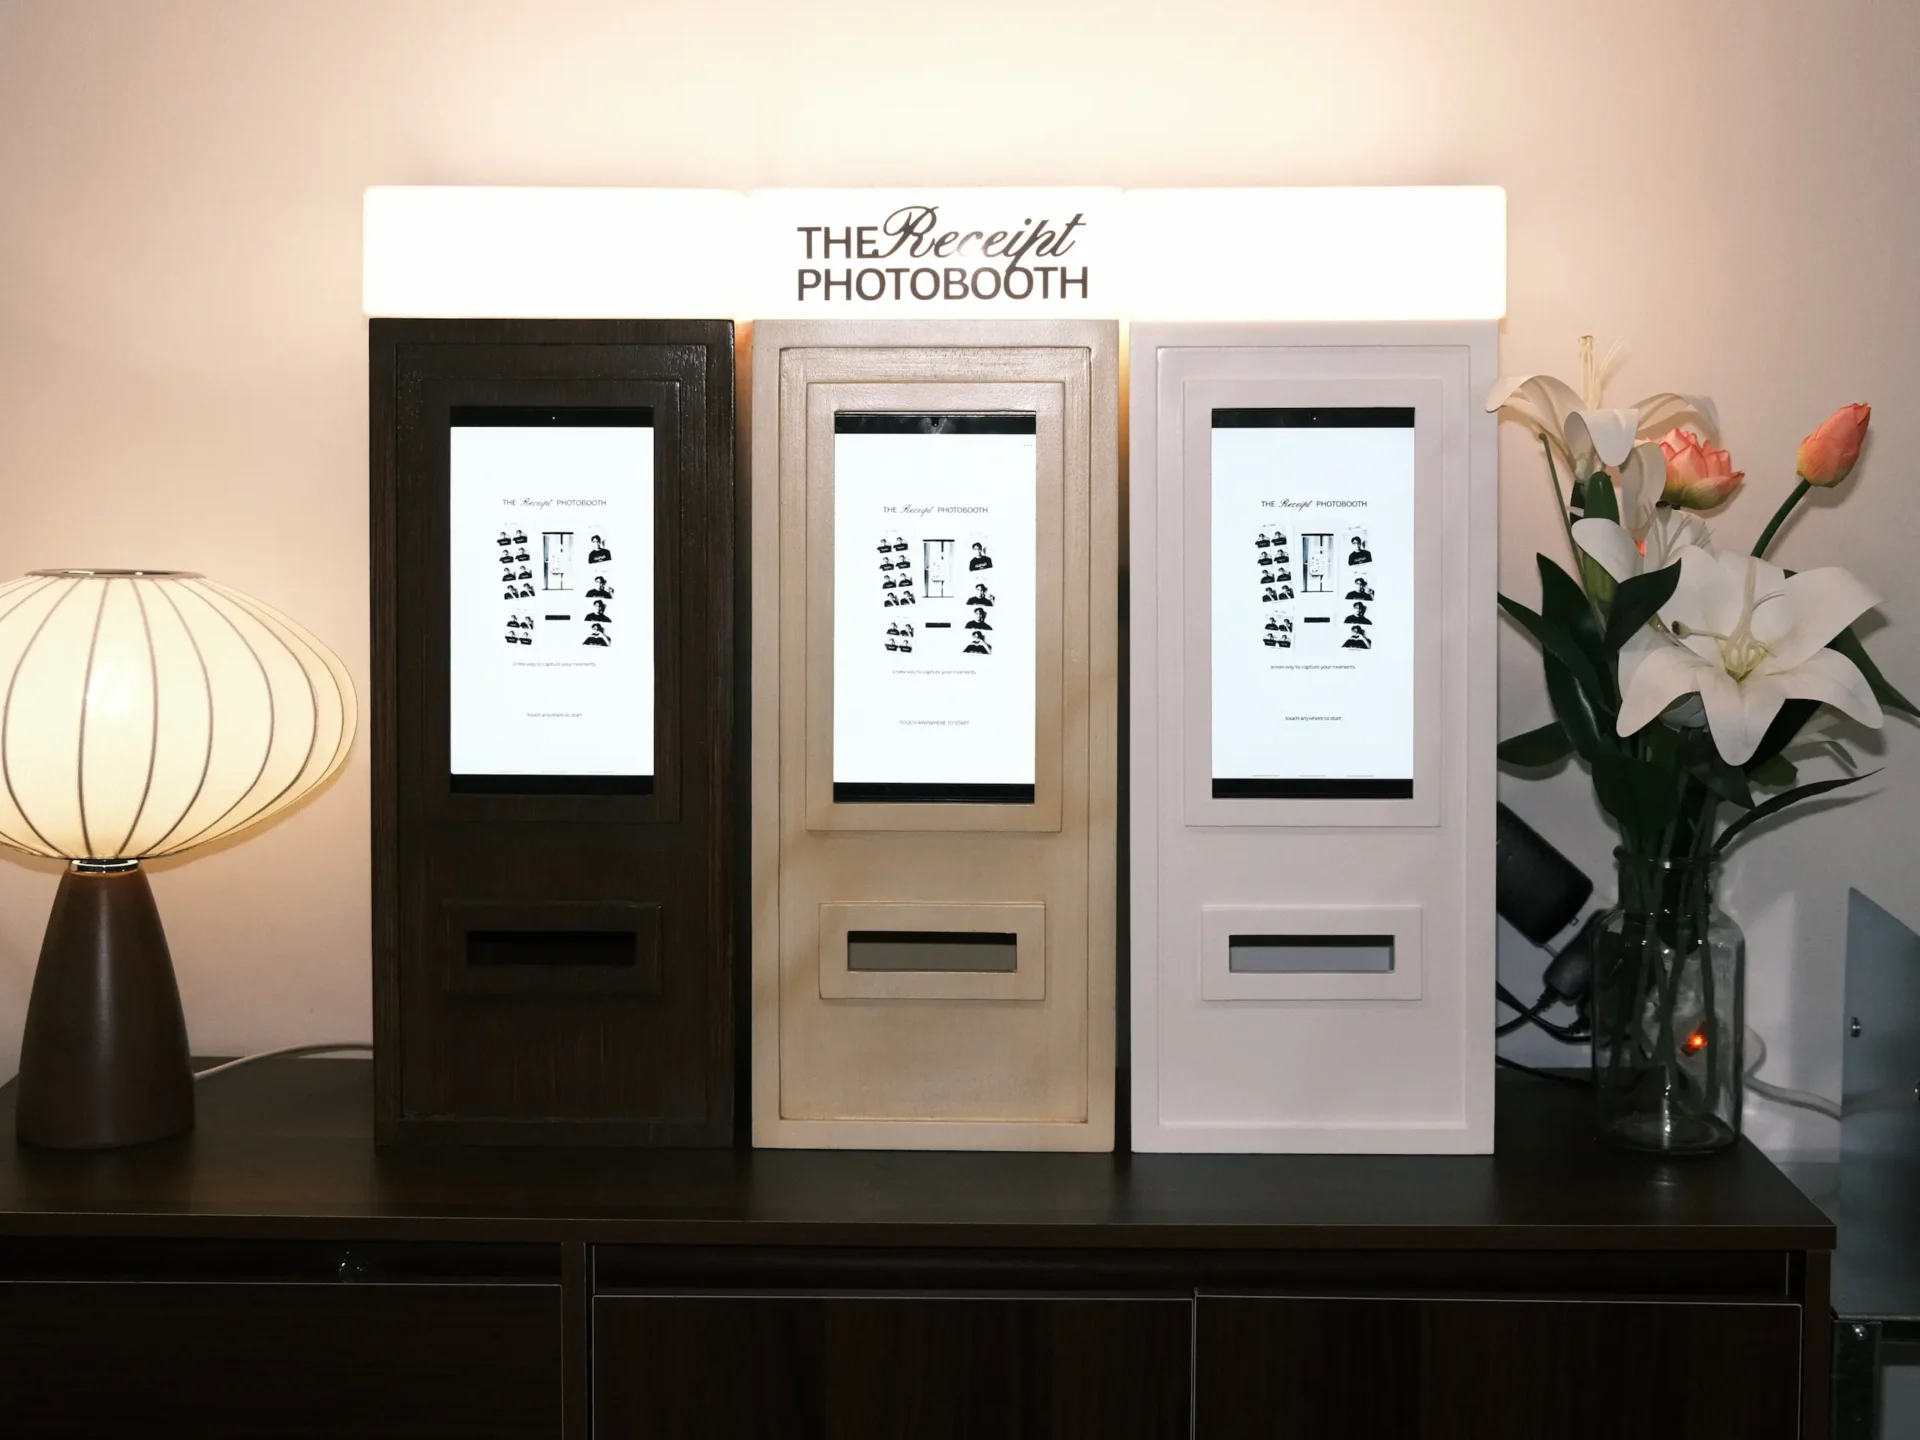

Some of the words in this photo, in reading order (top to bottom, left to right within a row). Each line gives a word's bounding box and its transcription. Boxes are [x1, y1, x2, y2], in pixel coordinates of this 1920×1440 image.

[796, 226, 879, 259] THE
[871, 205, 1087, 273] Receipt
[797, 266, 1089, 301] PHOTOBOOTH
[519, 497, 554, 511] Receipt
[556, 499, 607, 507] PHOTOBOOTH
[900, 504, 935, 517] Receipt
[937, 506, 989, 514] PHOTOBOOTH
[1261, 500, 1276, 508] THE
[1278, 498, 1313, 512] Receipt
[1316, 500, 1368, 508] PHOTOBOOTH
